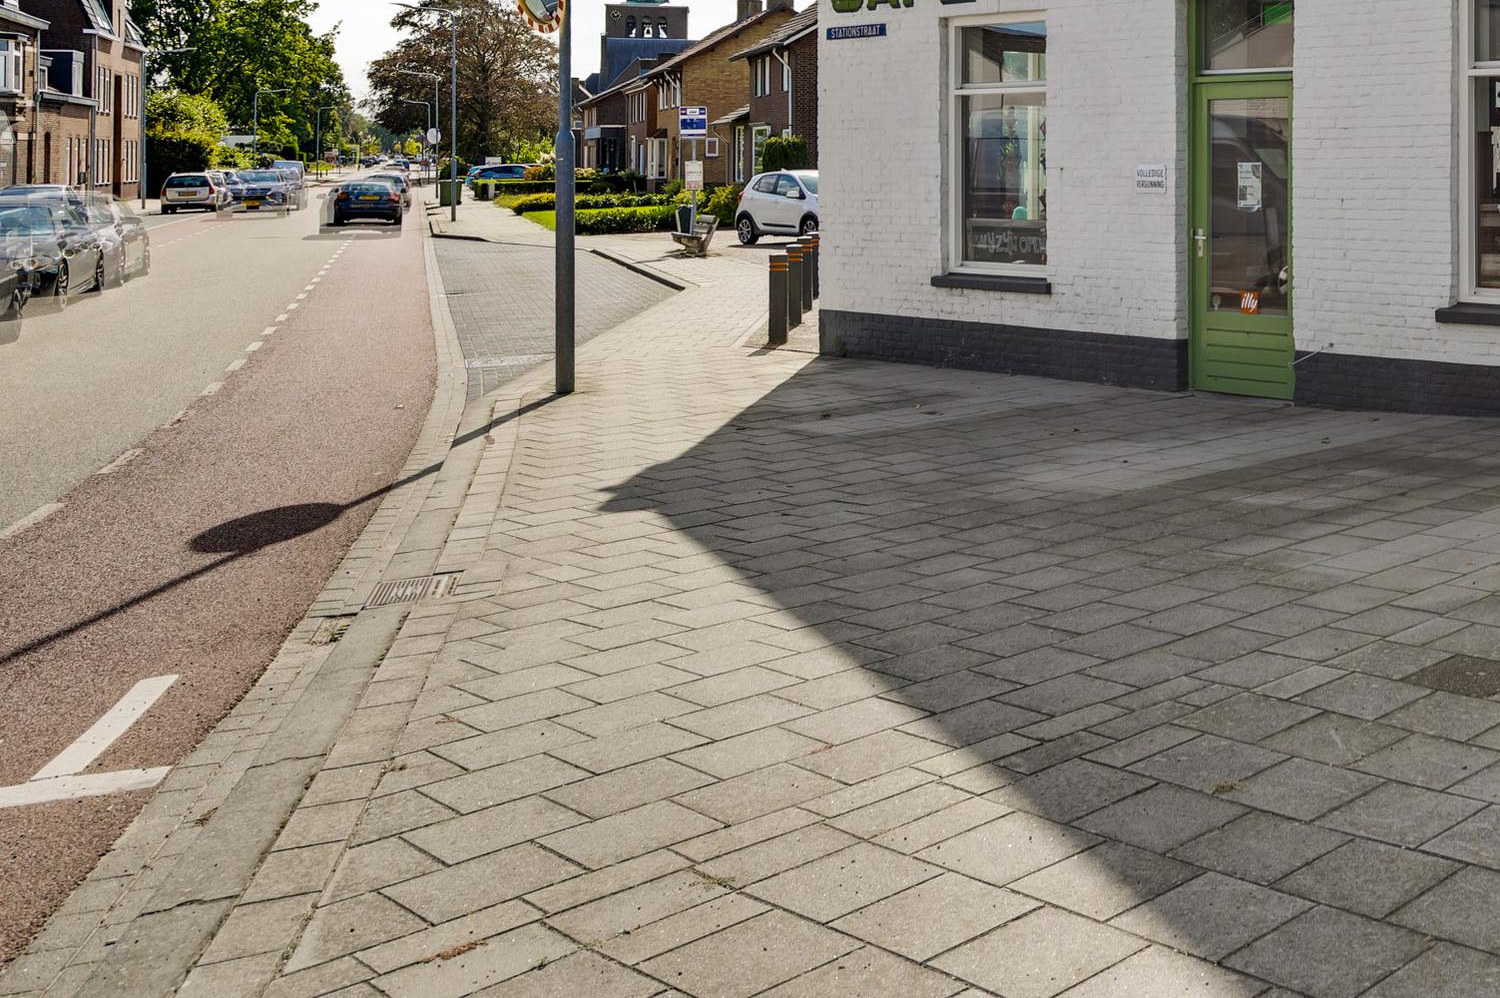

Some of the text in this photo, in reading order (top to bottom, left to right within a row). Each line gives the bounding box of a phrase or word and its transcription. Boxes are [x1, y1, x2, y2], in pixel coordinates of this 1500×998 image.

[831, 25, 880, 39] STATIONSTRAAT
[1136, 169, 1164, 178] VOLLEDIGE
[1240, 292, 1258, 313] illy
